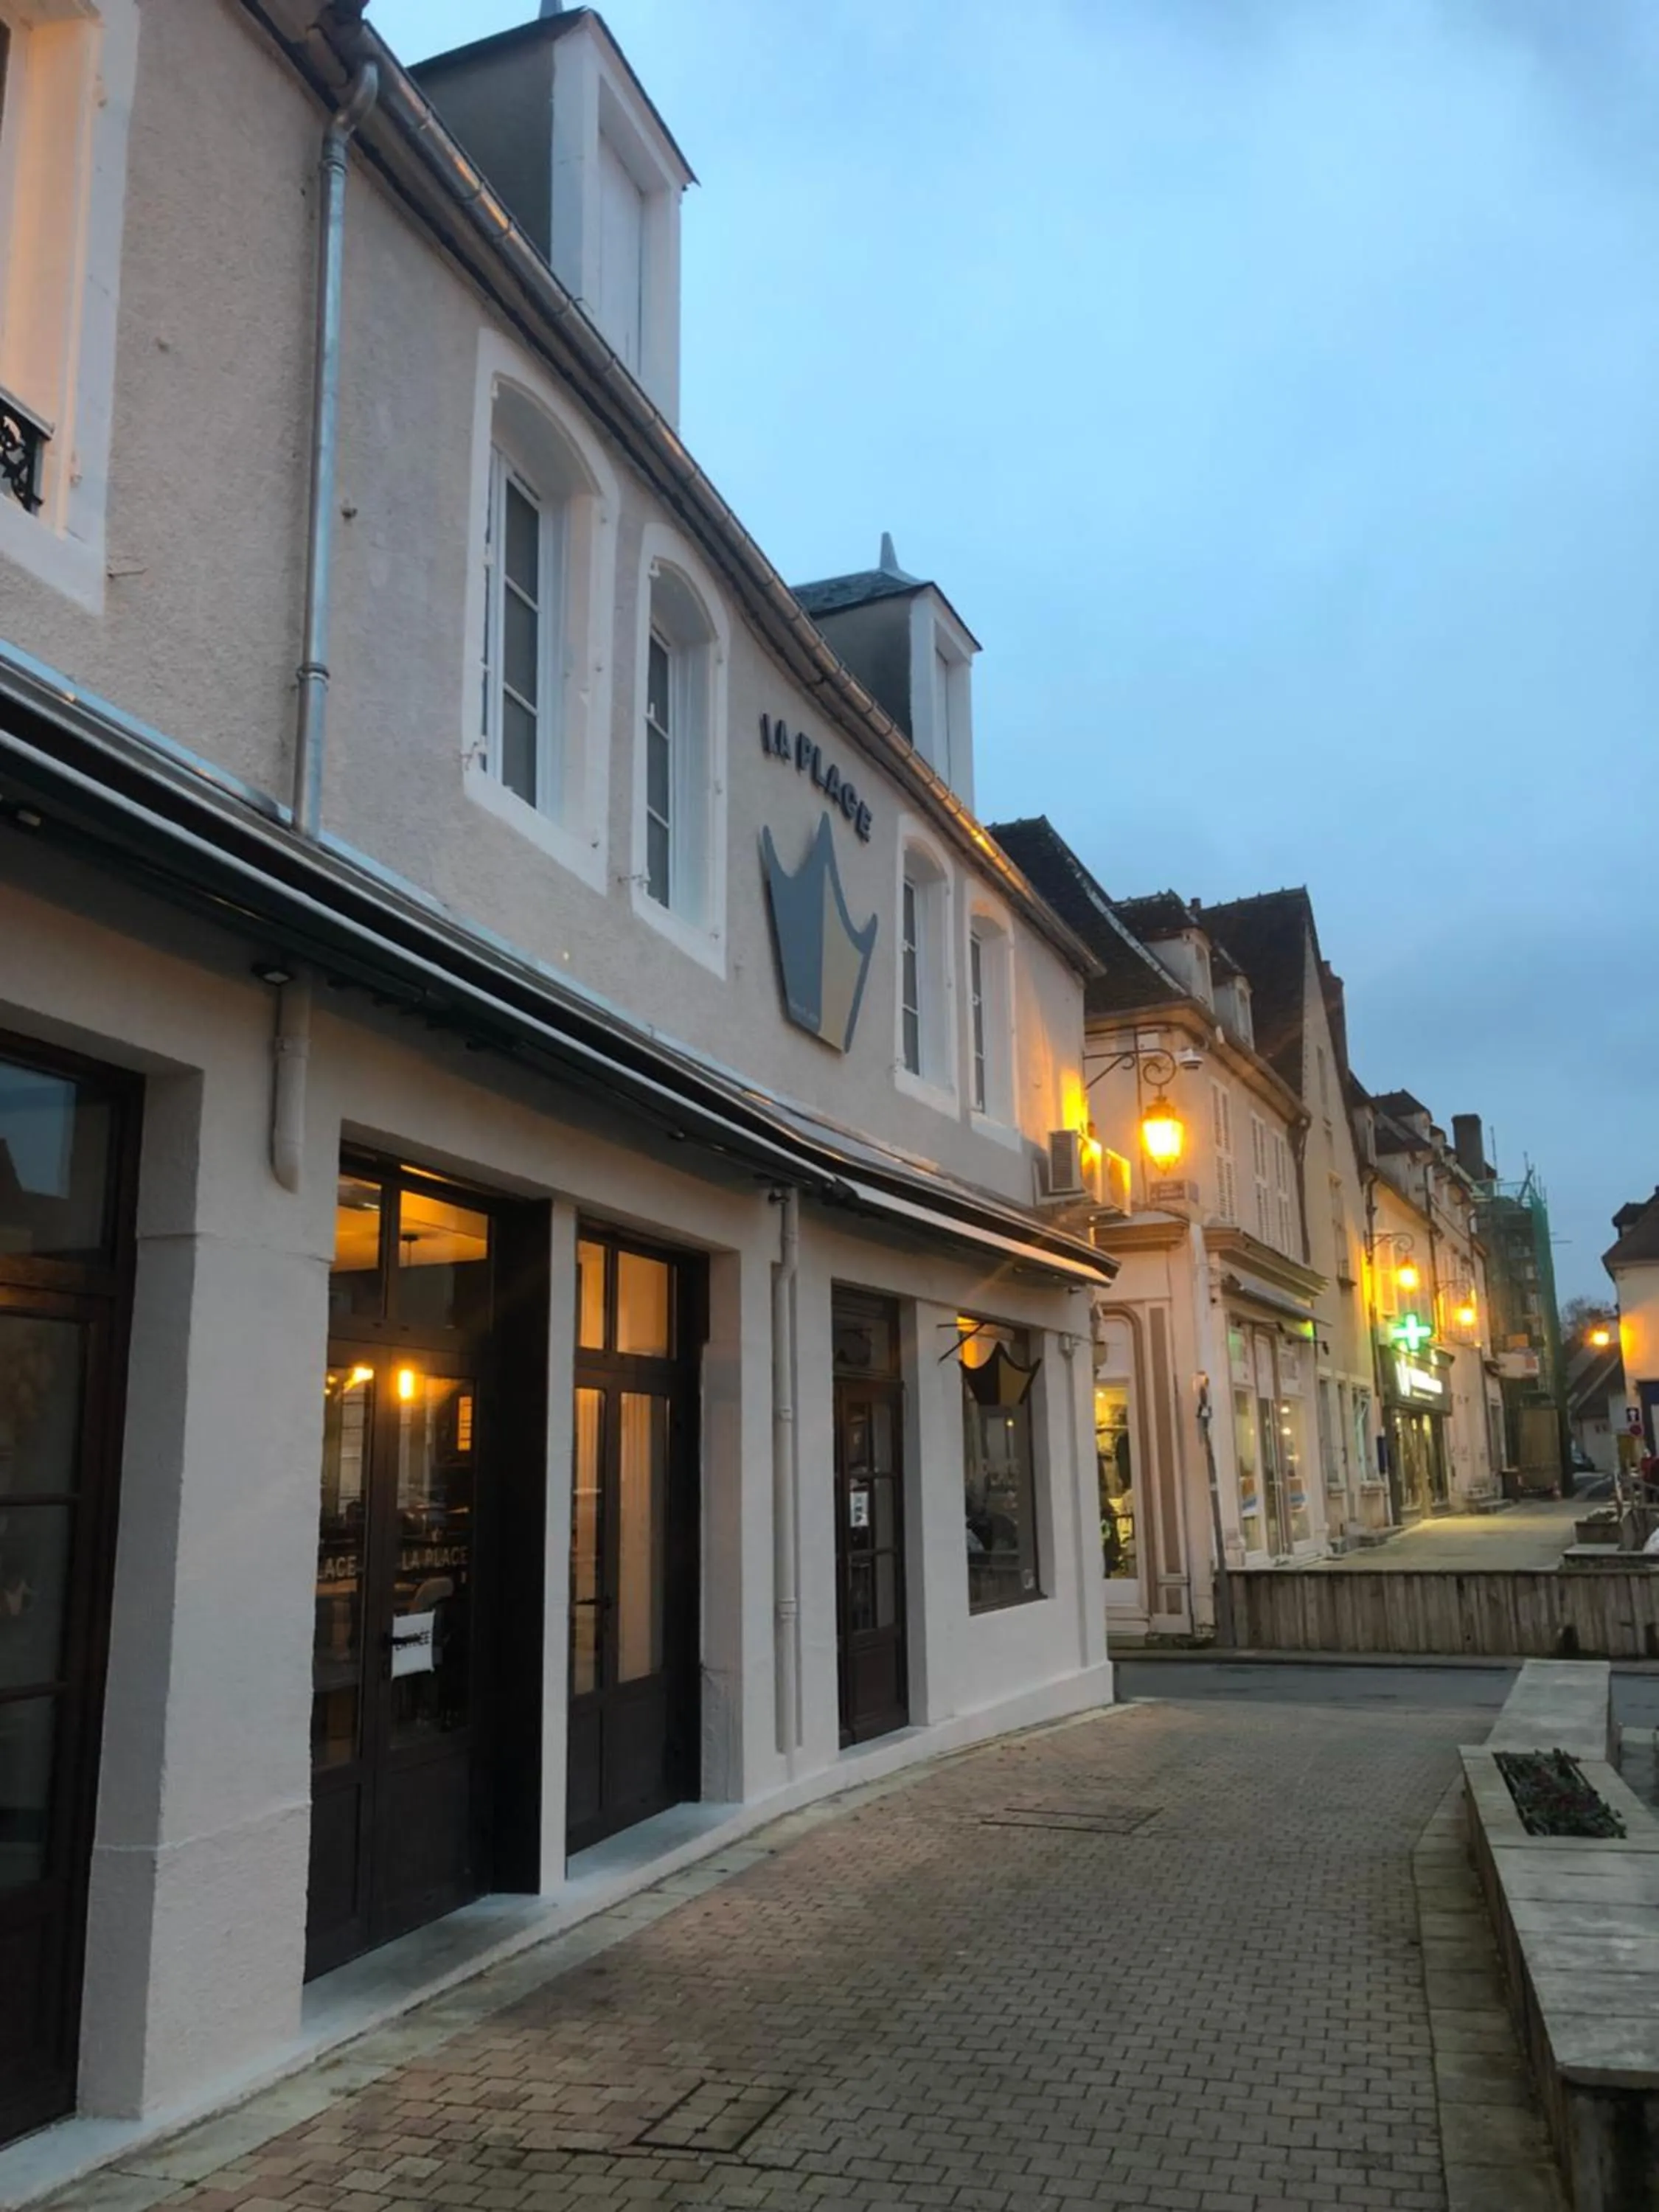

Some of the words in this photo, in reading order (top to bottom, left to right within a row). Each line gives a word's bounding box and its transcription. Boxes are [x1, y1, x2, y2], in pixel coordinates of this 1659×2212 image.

[760, 713, 791, 760] LA
[796, 732, 872, 844] PLACE
[401, 1551, 420, 1571] LA
[425, 1547, 468, 1568] PLACE
